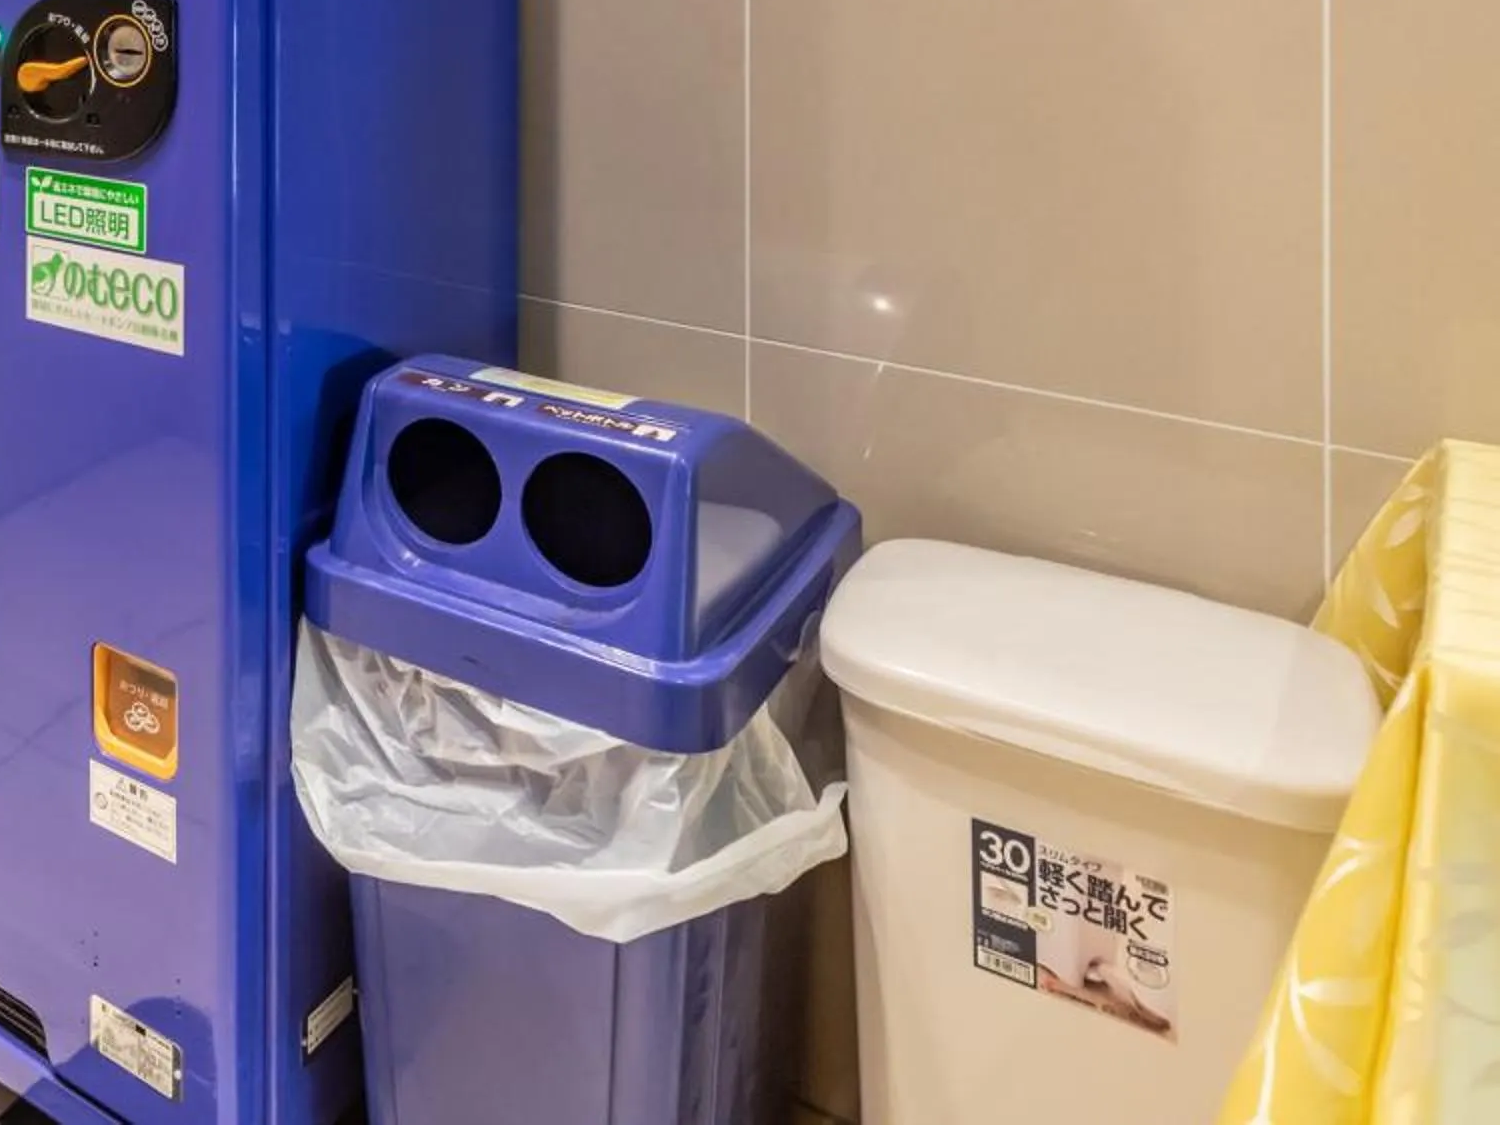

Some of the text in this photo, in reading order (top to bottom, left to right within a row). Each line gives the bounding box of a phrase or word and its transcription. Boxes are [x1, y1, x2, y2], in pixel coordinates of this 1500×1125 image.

[40, 200, 130, 241] LED照明
[63, 260, 179, 321] のむeco
[979, 829, 1032, 876] 30
[1037, 858, 1169, 923] 軽く踏んで
[1038, 886, 1149, 941] さっと開く
